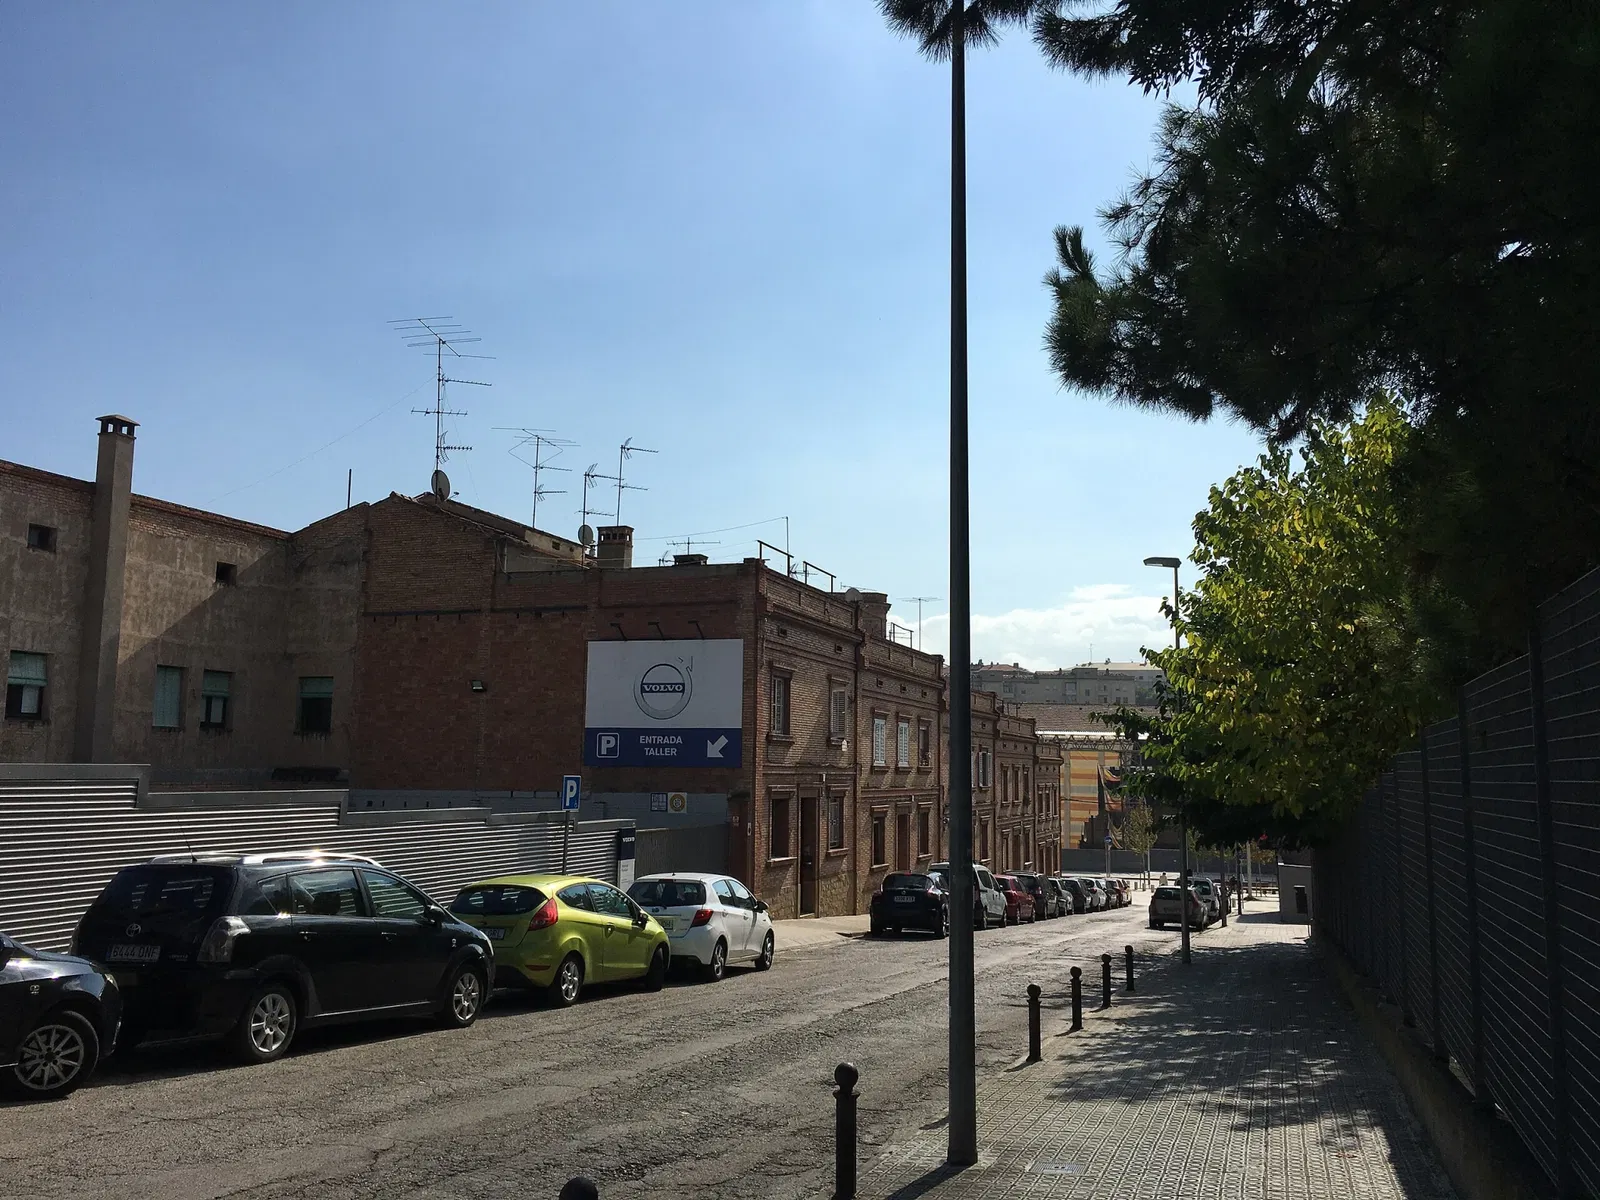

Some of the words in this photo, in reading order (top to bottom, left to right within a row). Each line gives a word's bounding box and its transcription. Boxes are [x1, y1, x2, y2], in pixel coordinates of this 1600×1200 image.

[643, 684, 683, 692] VOLVO
[639, 735, 683, 744] ENTRADA
[601, 736, 616, 755] P
[644, 747, 677, 756] TALLER
[565, 780, 577, 807] P
